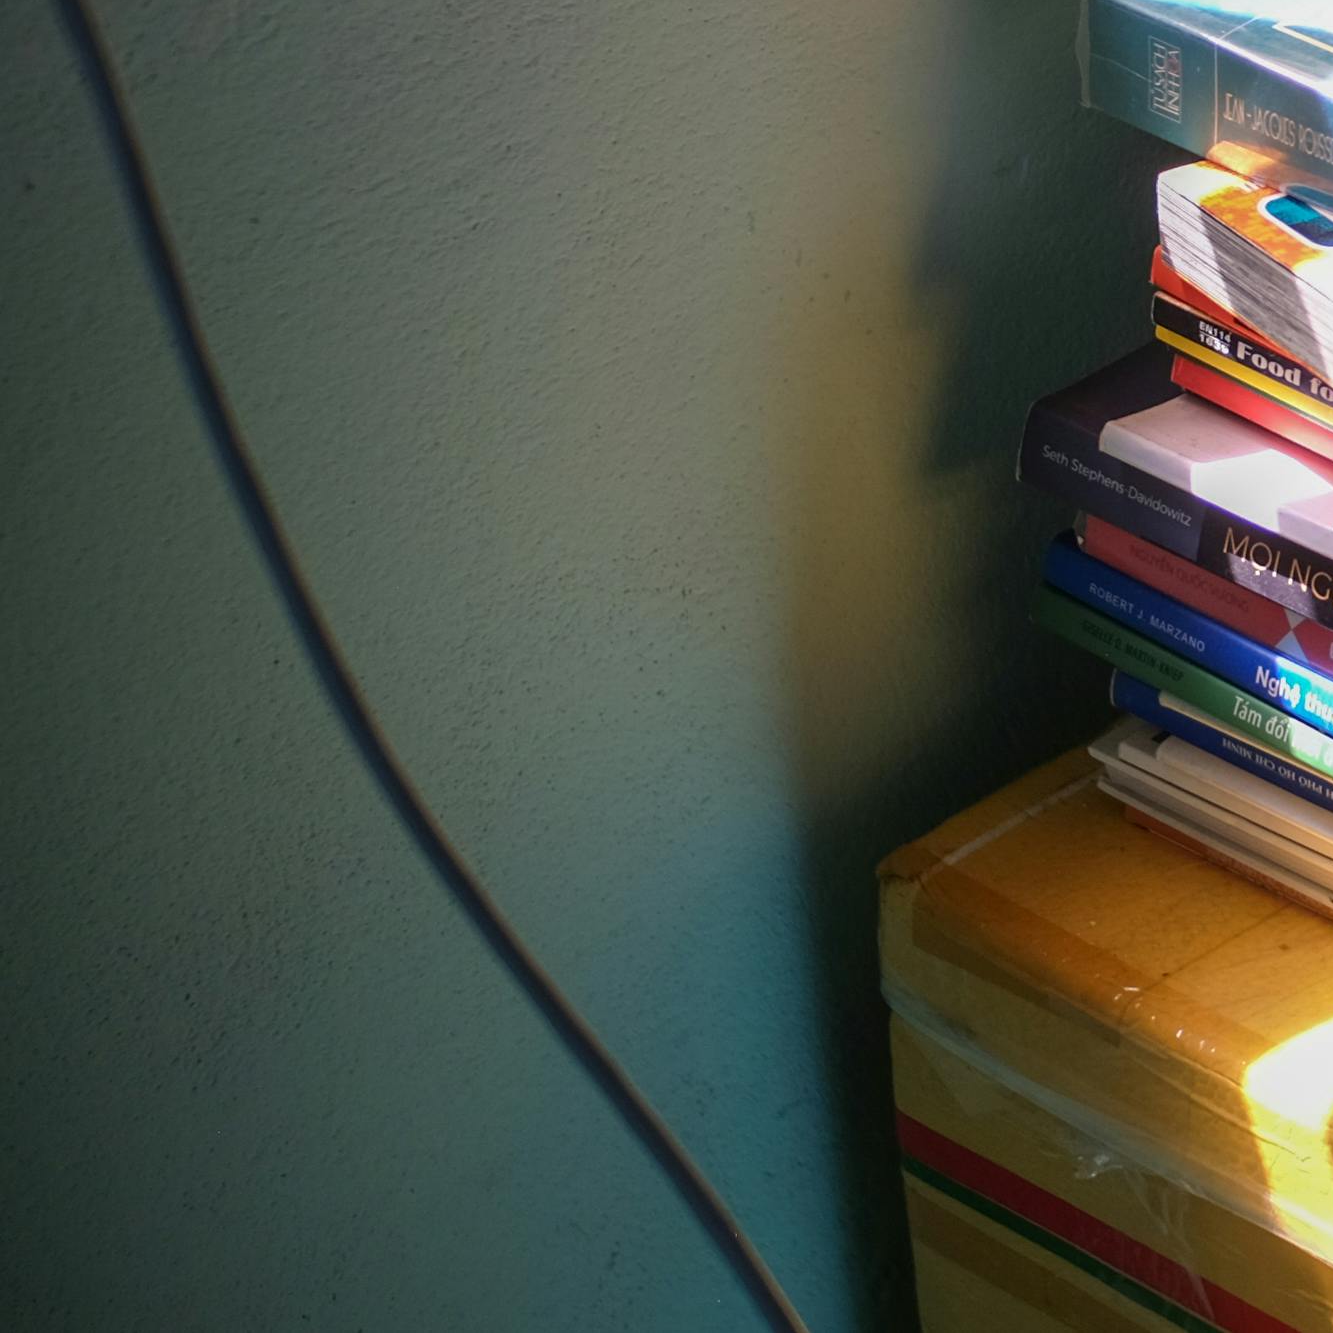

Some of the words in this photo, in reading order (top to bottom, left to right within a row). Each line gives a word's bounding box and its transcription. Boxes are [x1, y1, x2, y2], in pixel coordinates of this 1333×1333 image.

[1236, 341, 1301, 386] Food
[1042, 444, 1069, 467] Seth
[1223, 527, 1280, 577] MỌI
[1089, 582, 1135, 614] ROBERT
[1150, 615, 1206, 653] MARZANO
[1255, 666, 1301, 709] Nghệ
[1232, 695, 1263, 728] Tám
